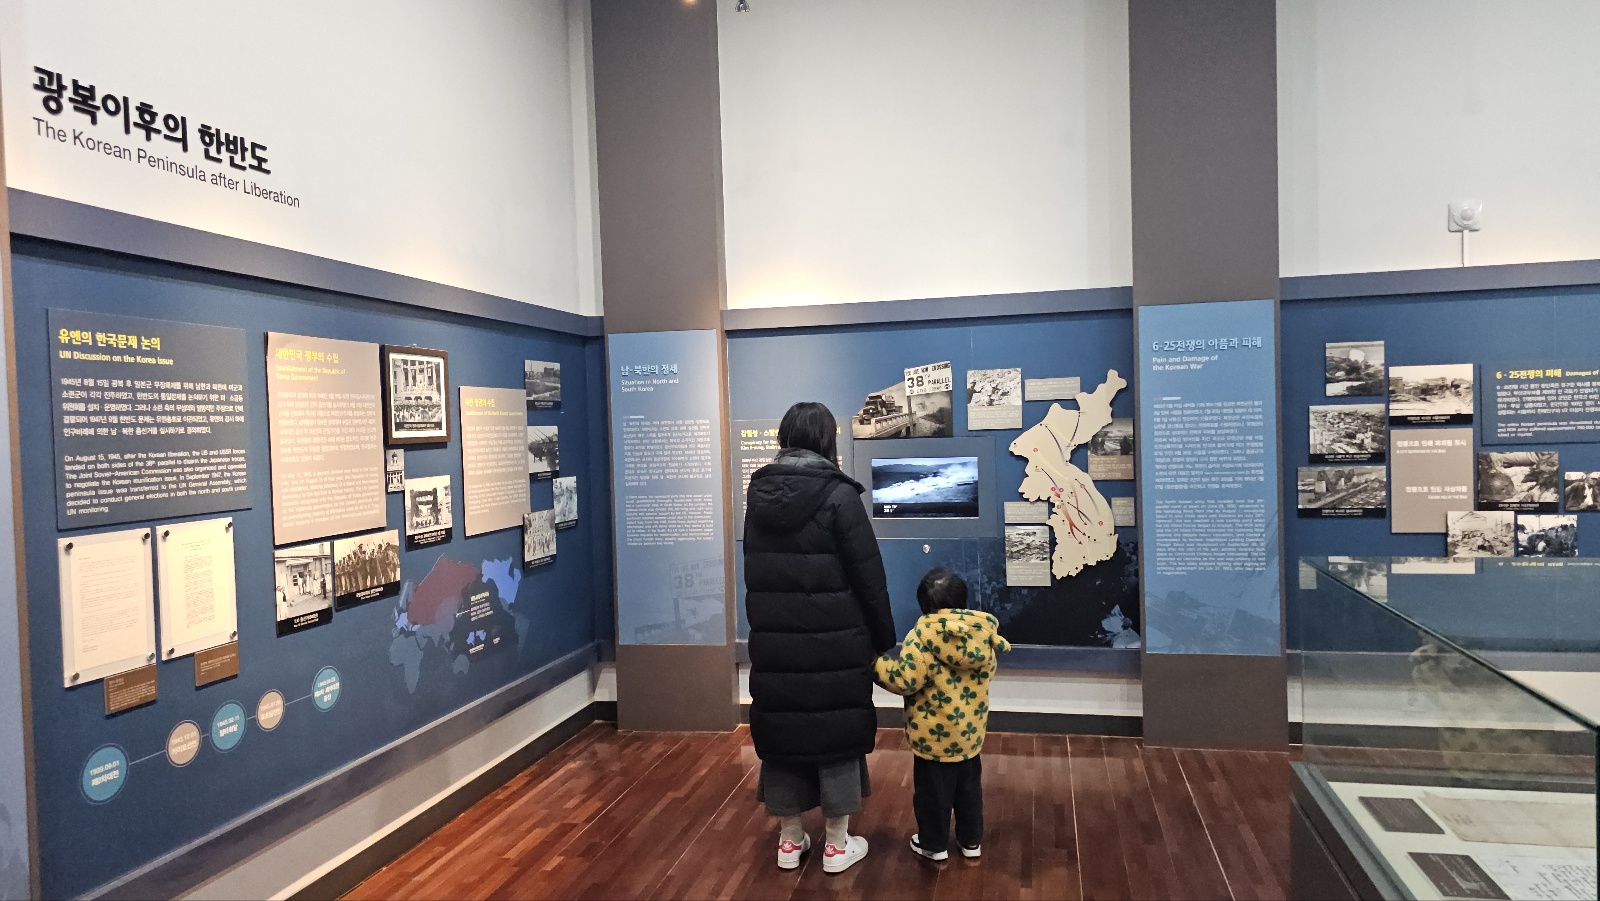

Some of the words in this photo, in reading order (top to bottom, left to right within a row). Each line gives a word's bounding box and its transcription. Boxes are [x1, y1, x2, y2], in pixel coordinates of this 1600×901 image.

[33, 65, 188, 152] 광복이후의
[198, 123, 272, 175] 한반도
[33, 117, 67, 142] The
[73, 128, 132, 161] Korean
[137, 148, 207, 183] Peninsula
[210, 172, 240, 192] after
[243, 179, 300, 208] Liberation
[58, 328, 92, 345] 유엔의
[95, 332, 138, 349] 한국문제
[141, 335, 160, 350] 논의
[1208, 338, 1239, 350] 아픔과
[1242, 336, 1262, 348] 피해
[59, 350, 71, 359] UN
[73, 351, 111, 361] Discussion
[123, 354, 135, 363] the
[136, 355, 156, 364] Korea
[158, 357, 174, 365] Issue
[326, 352, 338, 364] 수립
[1182, 355, 1210, 363] Damage
[661, 363, 678, 375] 정세
[1545, 368, 1562, 378] 피해
[907, 375, 924, 388] 38
[76, 454, 96, 462] August
[90, 760, 120, 776] 1939.09.01
